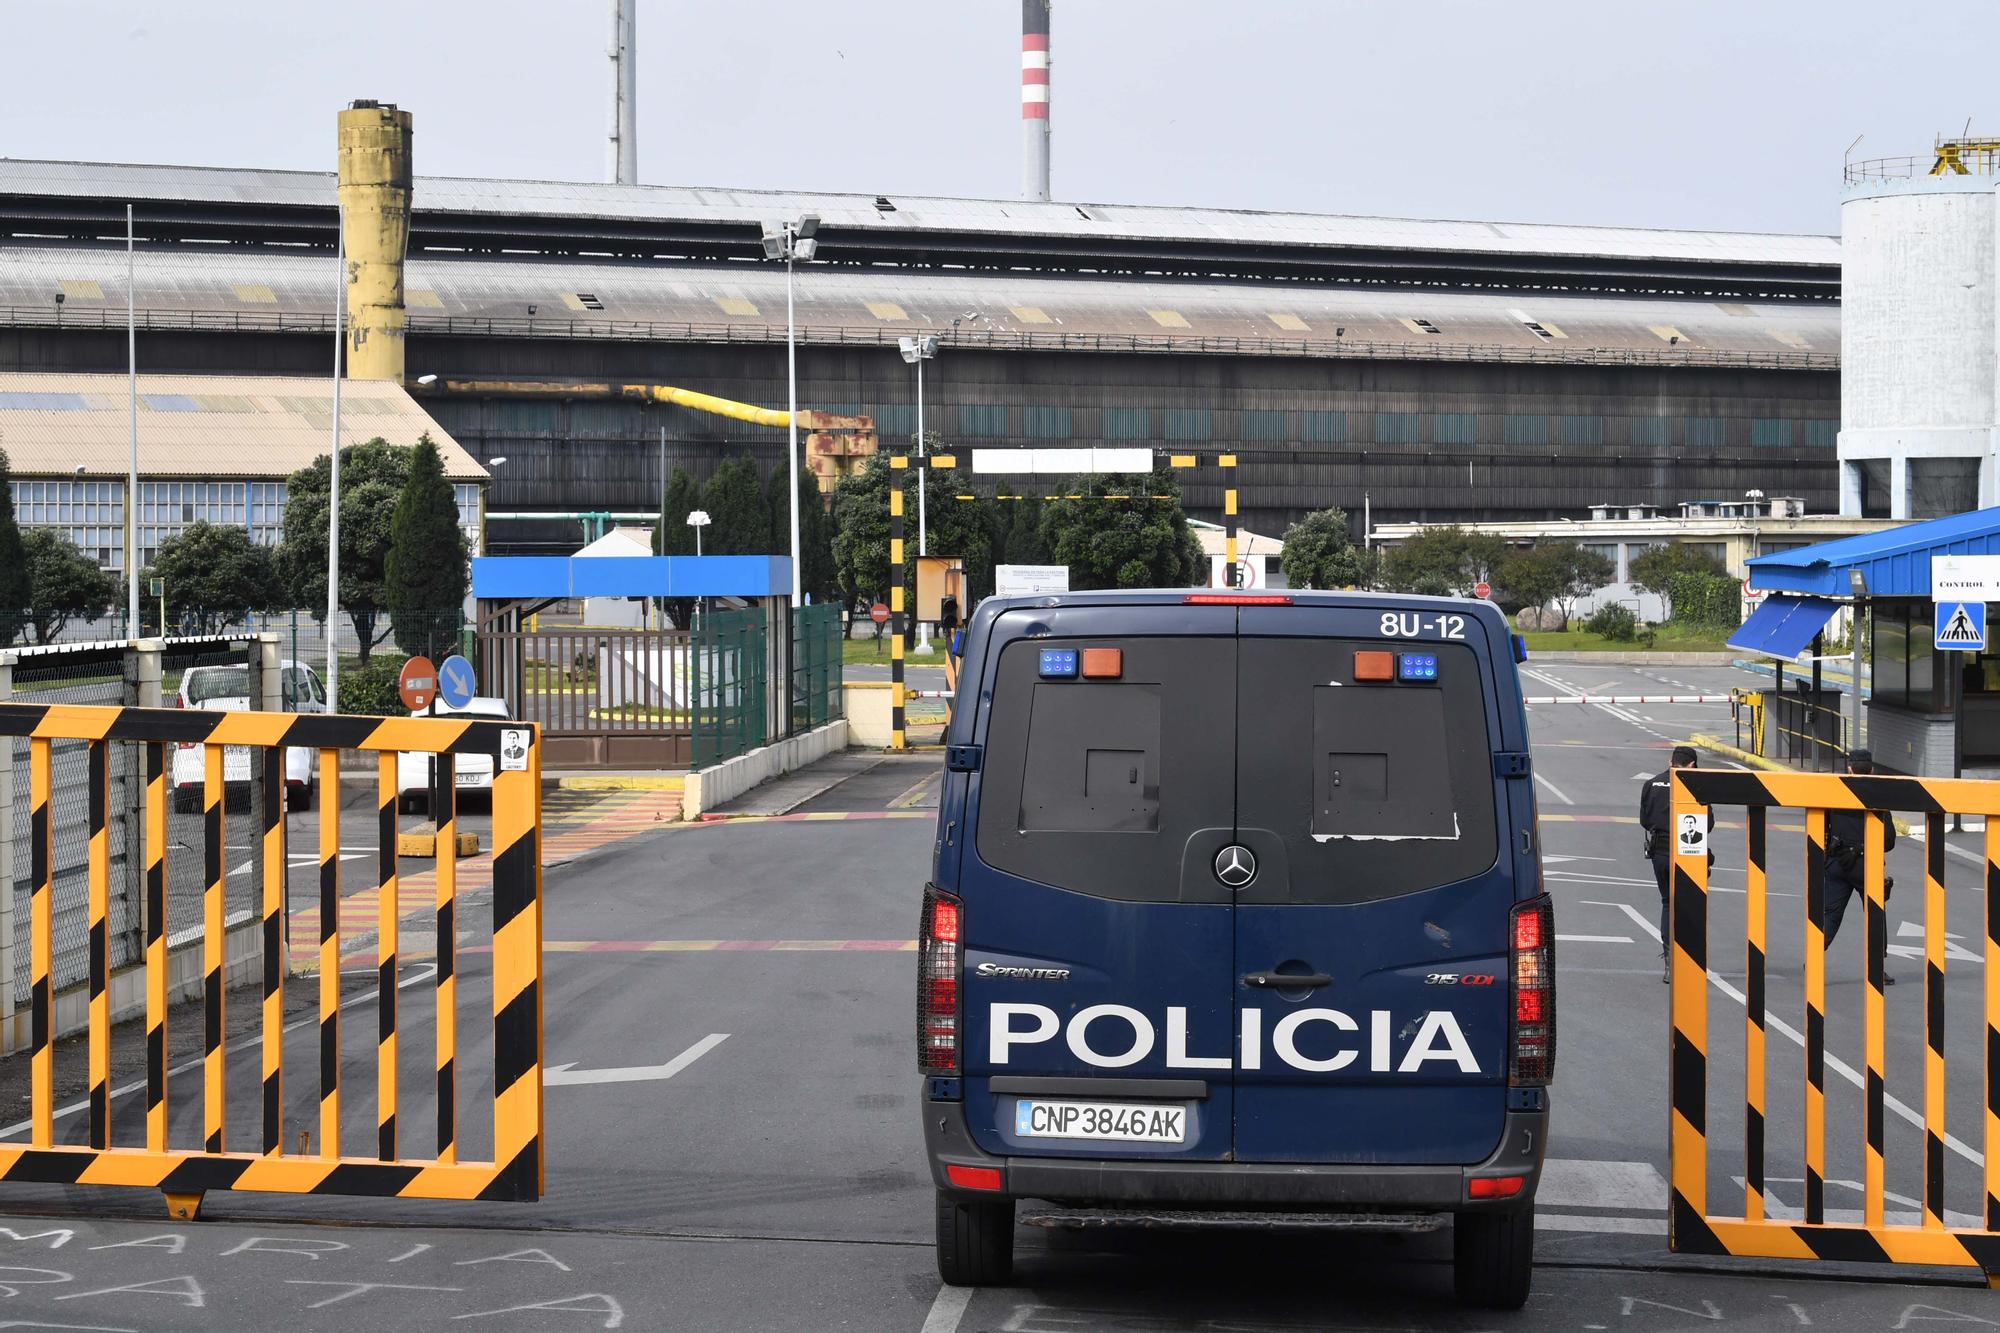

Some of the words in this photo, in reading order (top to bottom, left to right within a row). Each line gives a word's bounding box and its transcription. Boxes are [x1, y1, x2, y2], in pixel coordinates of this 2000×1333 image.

[1380, 612, 1465, 639] 8U-12
[1424, 973, 1459, 985] 315
[1461, 974, 1495, 985] CDI
[989, 1003, 1482, 1073] POLICIA
